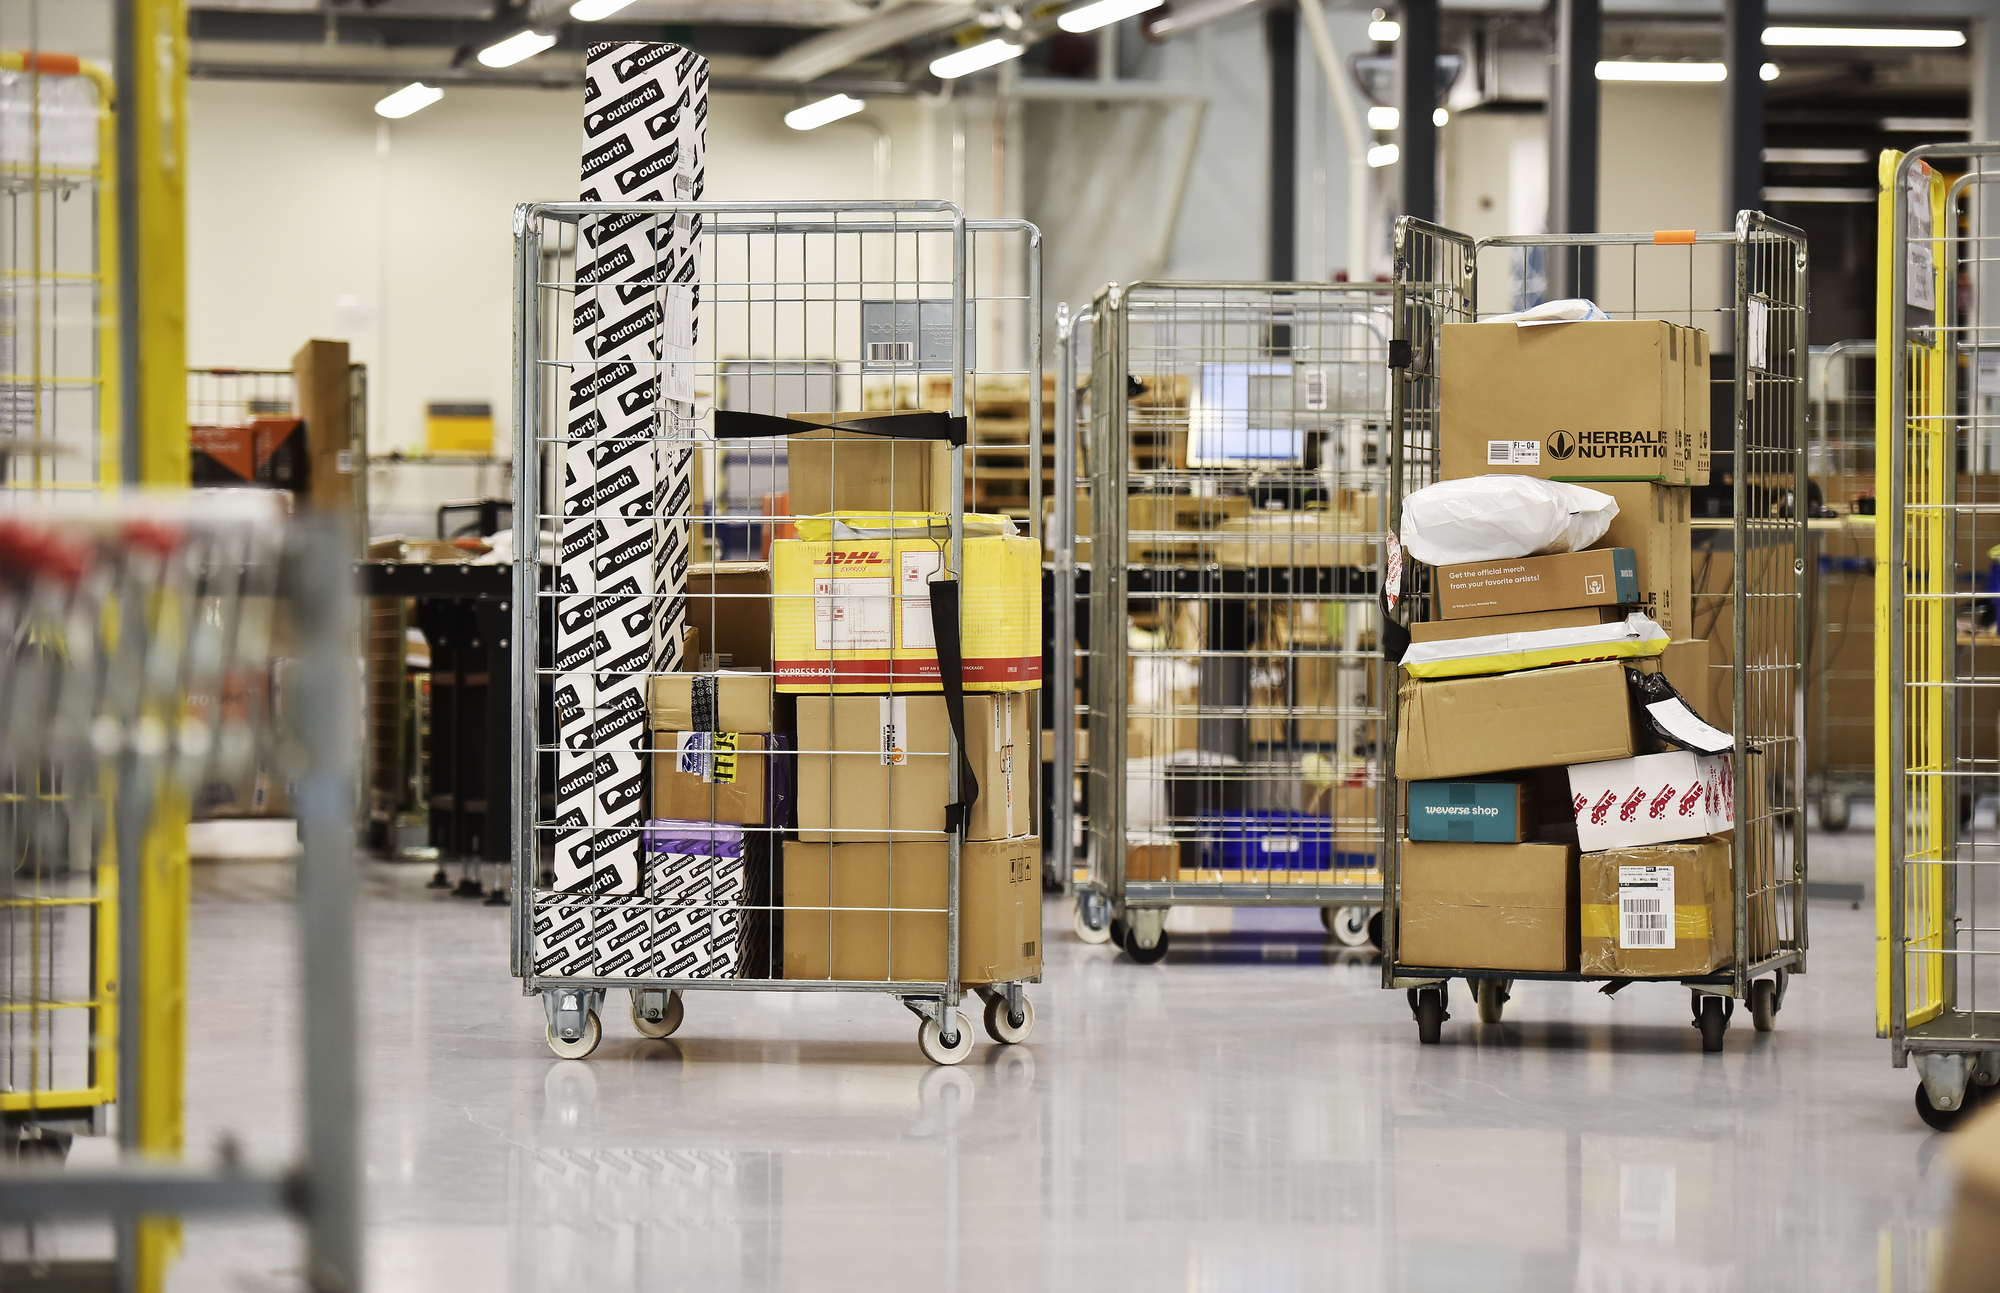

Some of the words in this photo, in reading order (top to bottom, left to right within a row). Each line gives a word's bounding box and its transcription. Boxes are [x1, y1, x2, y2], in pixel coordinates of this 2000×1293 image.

[606, 87, 657, 122] outnorth
[579, 364, 630, 397] outnorth
[824, 551, 884, 565] DHL
[1477, 567, 1502, 576] official
[1503, 565, 1526, 574] merch
[1468, 581, 1484, 589] your
[1485, 577, 1514, 586] favorite
[1514, 574, 1540, 583] artists!
[779, 668, 815, 677] EXPRESS
[1425, 806, 1471, 815] weverse
[1472, 805, 1499, 817] shop
[672, 855, 693, 870] outnorth
[661, 879, 681, 894] outnorth
[688, 879, 708, 894] outnorth
[714, 880, 735, 895] outnorth
[555, 922, 582, 941] outnorth
[587, 923, 614, 941] otnorth
[619, 925, 646, 943] outnorth
[683, 927, 710, 945] outnorth
[540, 950, 566, 969] outnorth
[604, 953, 631, 971] outnorth
[668, 956, 694, 974] outnorth
[700, 957, 727, 975] outorth
